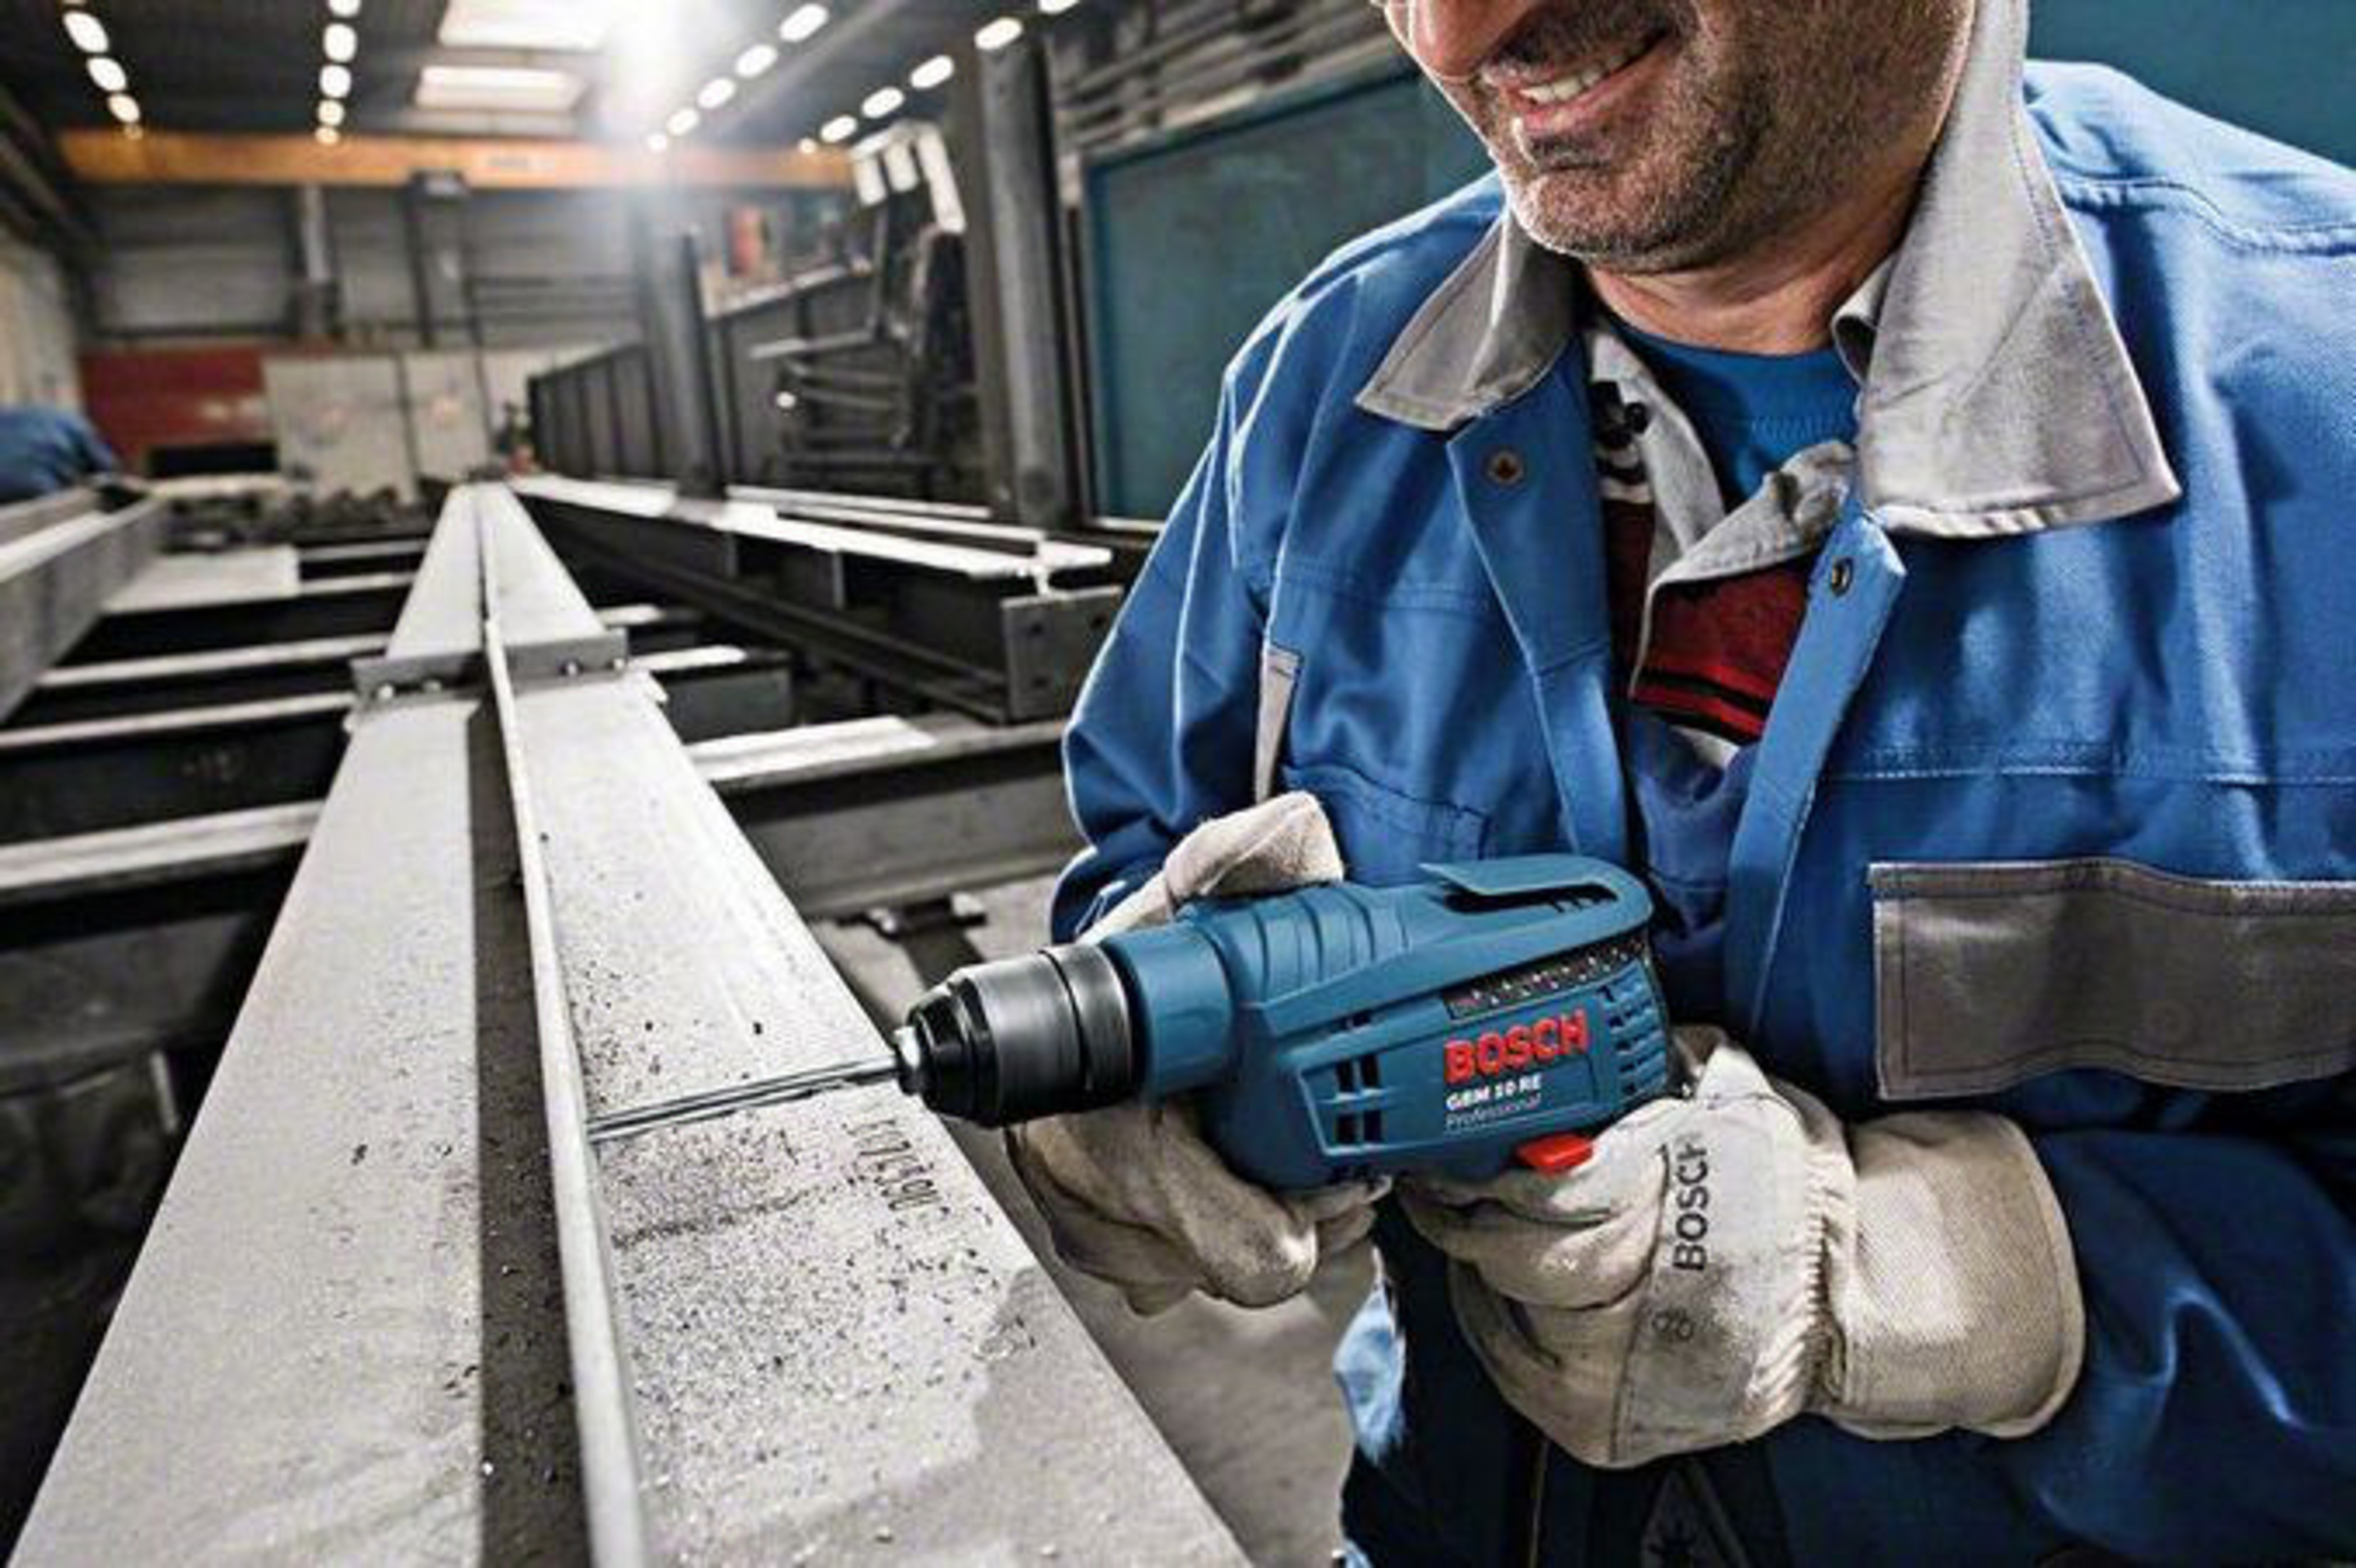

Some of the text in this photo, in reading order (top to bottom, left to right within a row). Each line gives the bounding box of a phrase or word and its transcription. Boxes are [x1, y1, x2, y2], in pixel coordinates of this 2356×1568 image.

[1444, 1009, 1588, 1083] BOSCH
[1446, 1072, 1543, 1111] GBM 10 RE
